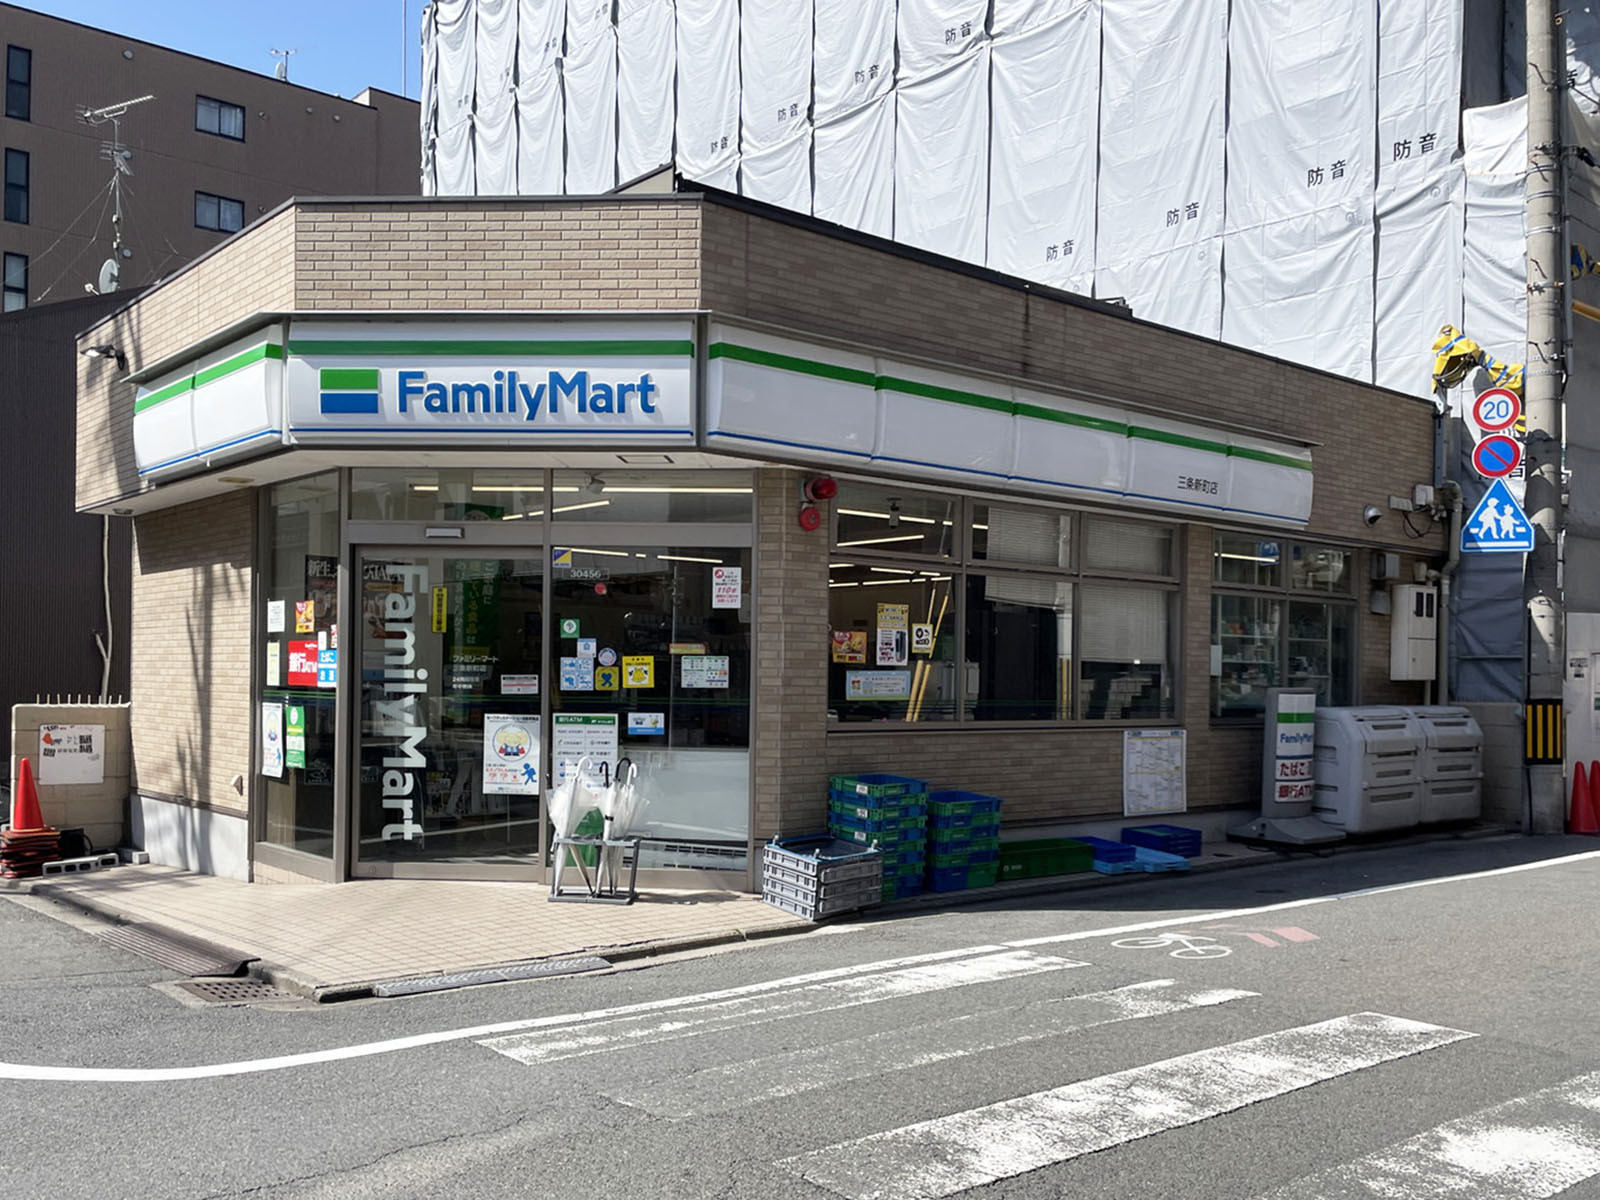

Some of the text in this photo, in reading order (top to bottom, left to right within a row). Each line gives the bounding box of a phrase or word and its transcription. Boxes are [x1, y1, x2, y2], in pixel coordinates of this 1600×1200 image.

[944, 21, 973, 45] 防音
[854, 64, 880, 85] 防音
[777, 102, 800, 122] 防音
[1393, 132, 1437, 161] 防音
[1307, 160, 1346, 188] 防音
[1166, 201, 1200, 228] 防音
[1046, 239, 1075, 262] 防音
[398, 369, 656, 421] FamilyMart
[1483, 400, 1510, 420] 20
[570, 568, 601, 580] 30456
[377, 564, 431, 841] FamilyMart
[1280, 761, 1305, 777] たばこ
